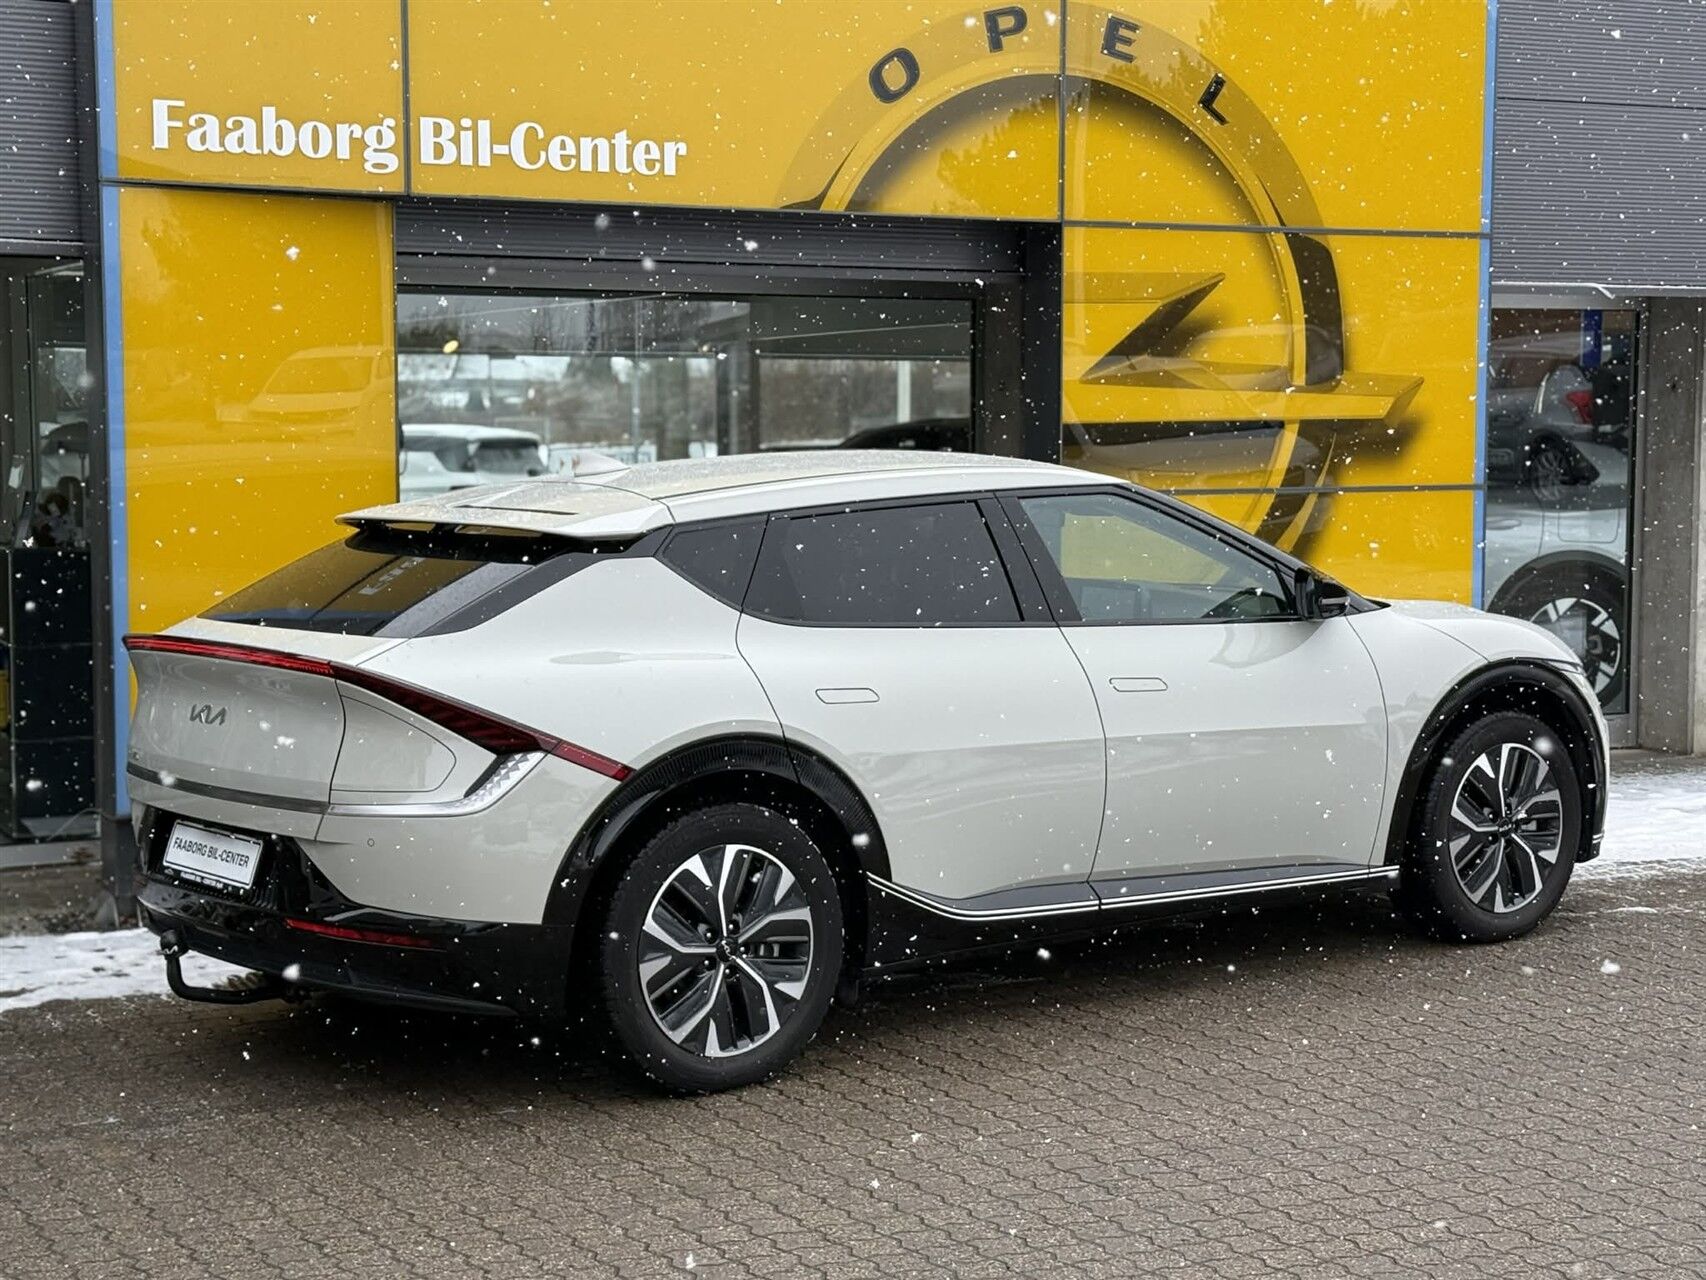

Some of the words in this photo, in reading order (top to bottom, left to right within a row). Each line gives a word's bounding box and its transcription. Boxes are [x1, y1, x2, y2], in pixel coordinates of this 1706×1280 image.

[868, 5, 1231, 126] OPEL
[151, 97, 399, 174] Faaborg
[418, 115, 688, 177] Bil-Center
[173, 837, 208, 857] FAABORG
[207, 845, 250, 868] BIL-CENTER
